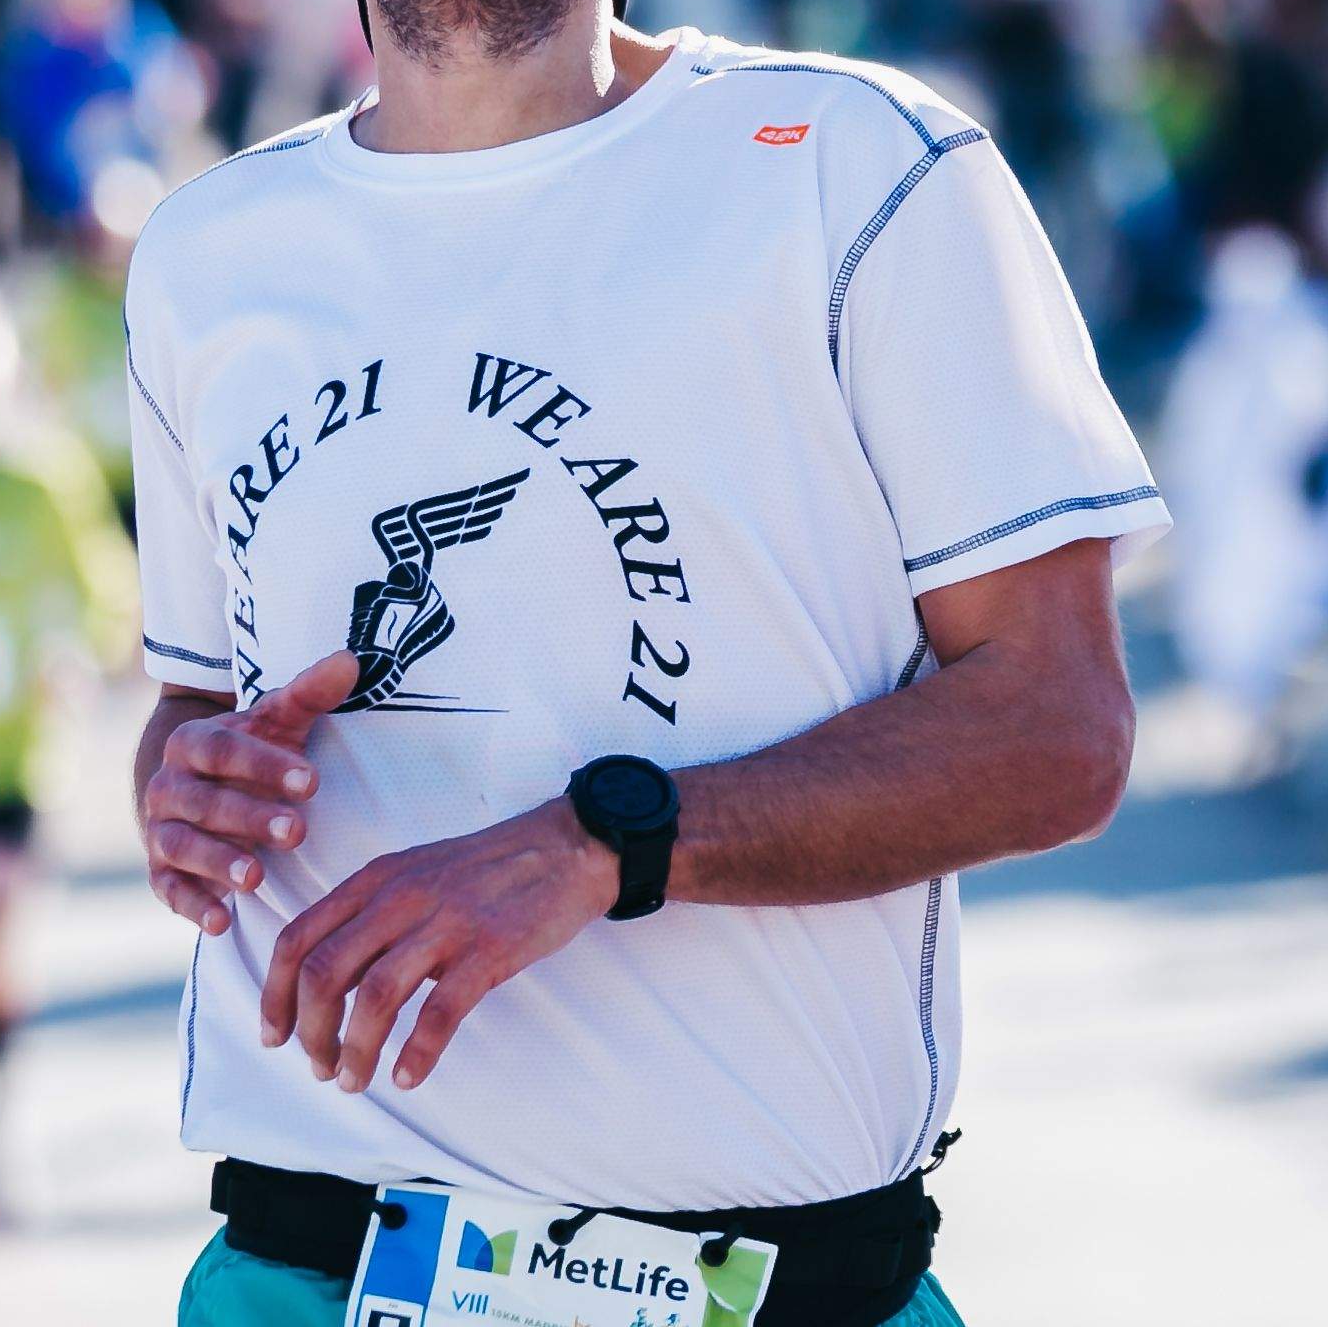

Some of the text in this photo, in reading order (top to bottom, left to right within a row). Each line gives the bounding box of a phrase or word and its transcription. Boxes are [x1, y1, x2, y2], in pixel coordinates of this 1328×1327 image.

[226, 413, 301, 585] ARE
[313, 358, 384, 445] 21
[468, 352, 692, 727] WE ARE 21
[452, 1290, 490, 1315] VIII
[528, 1243, 690, 1302] MetLife
